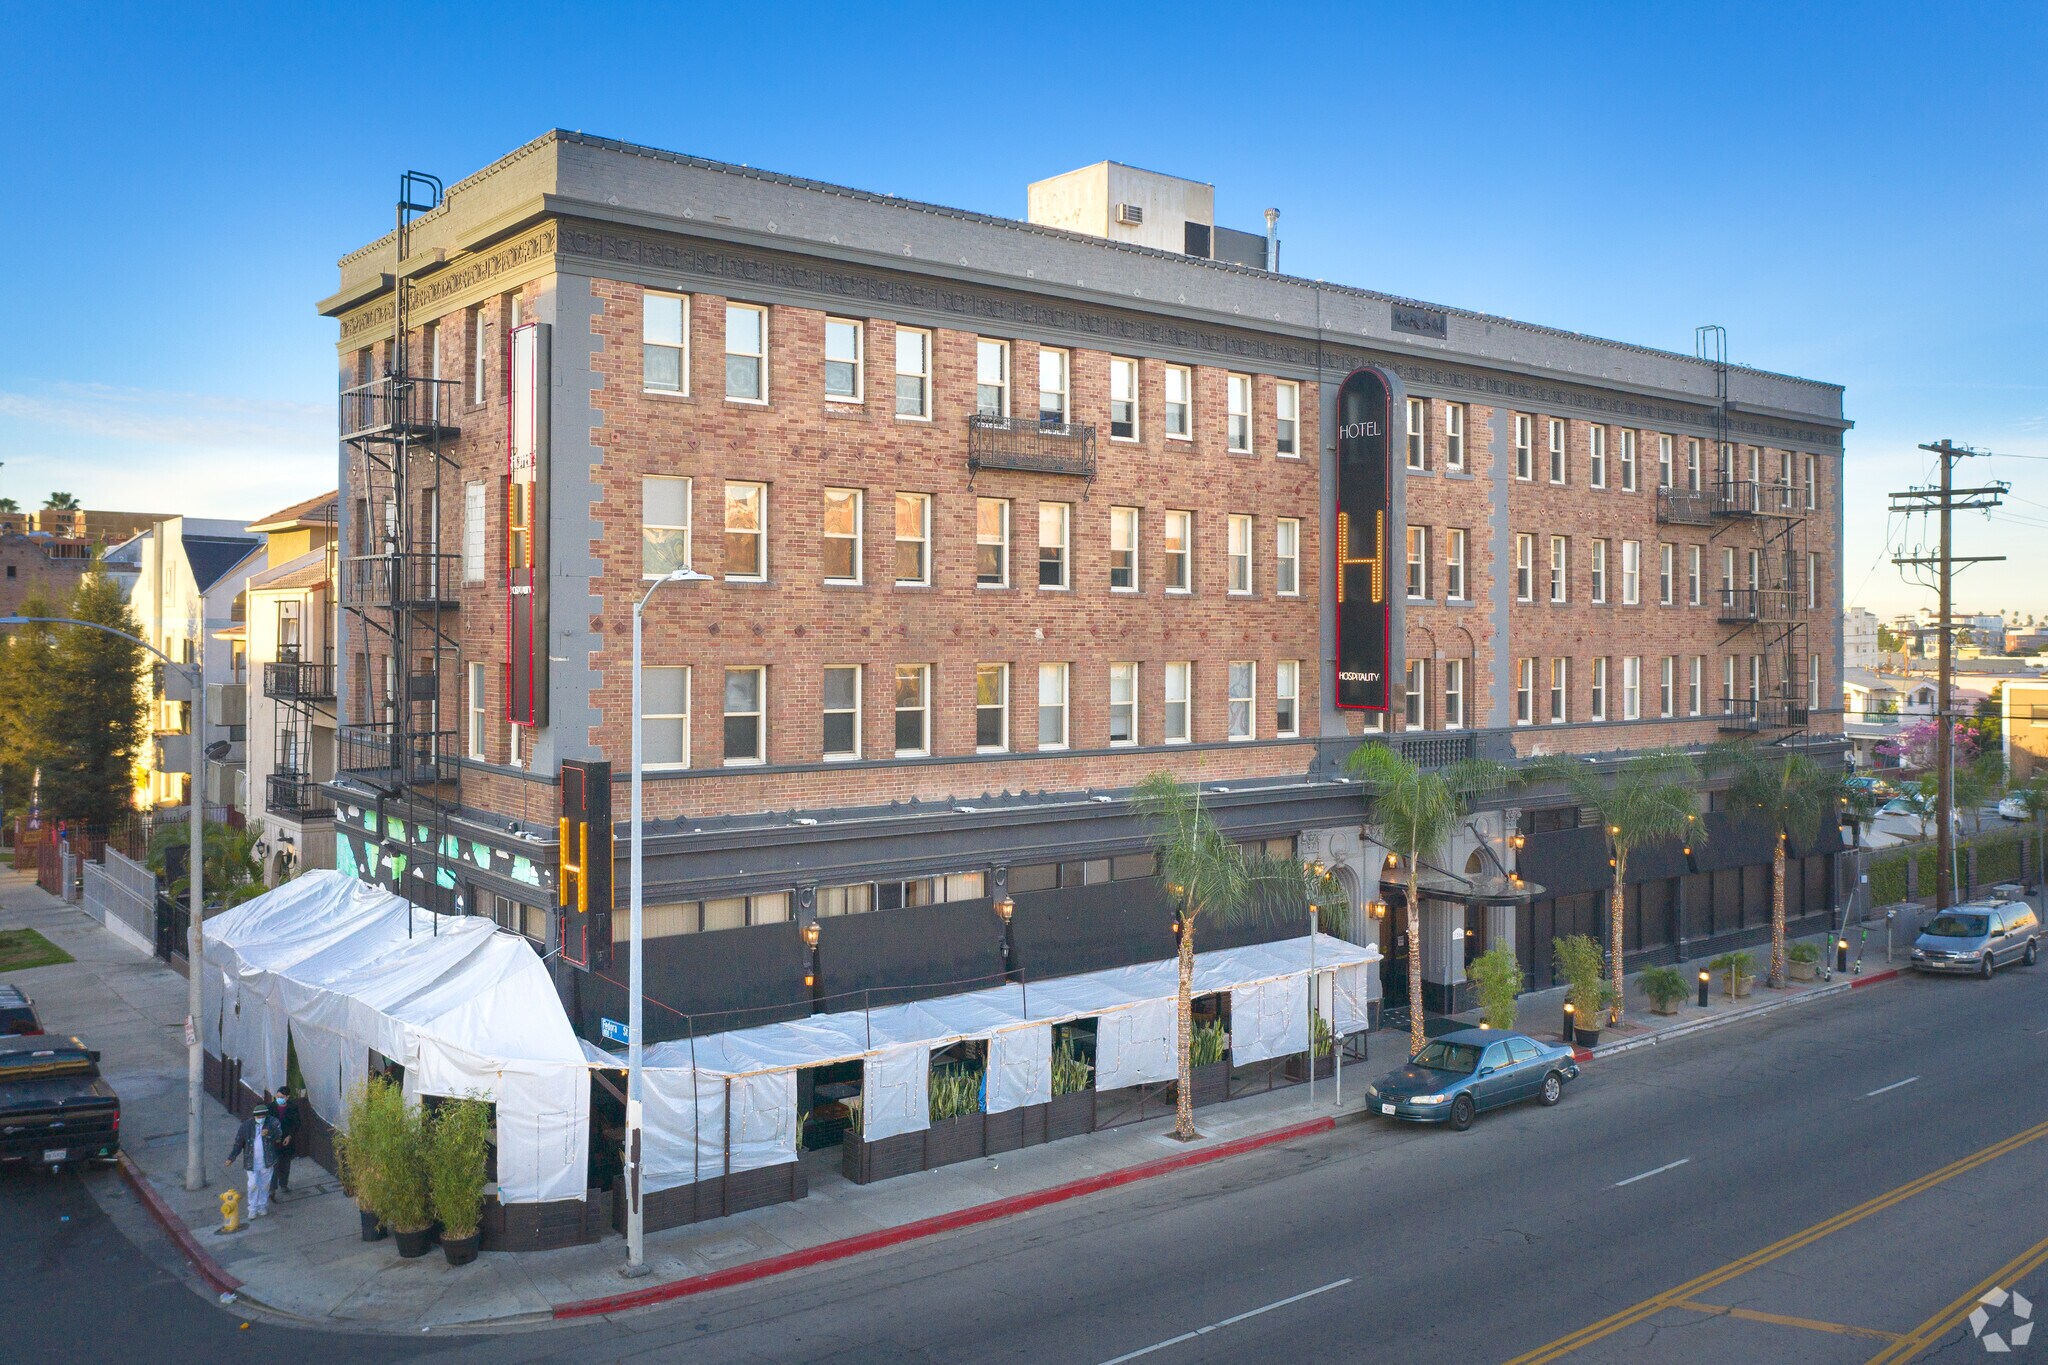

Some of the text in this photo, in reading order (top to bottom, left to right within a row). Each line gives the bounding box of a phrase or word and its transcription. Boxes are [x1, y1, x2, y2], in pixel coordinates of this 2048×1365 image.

[1339, 421, 1381, 439] HOTEL
[1338, 509, 1383, 604] H
[1338, 671, 1380, 682] HOSPITALITY
[559, 816, 588, 914] H
